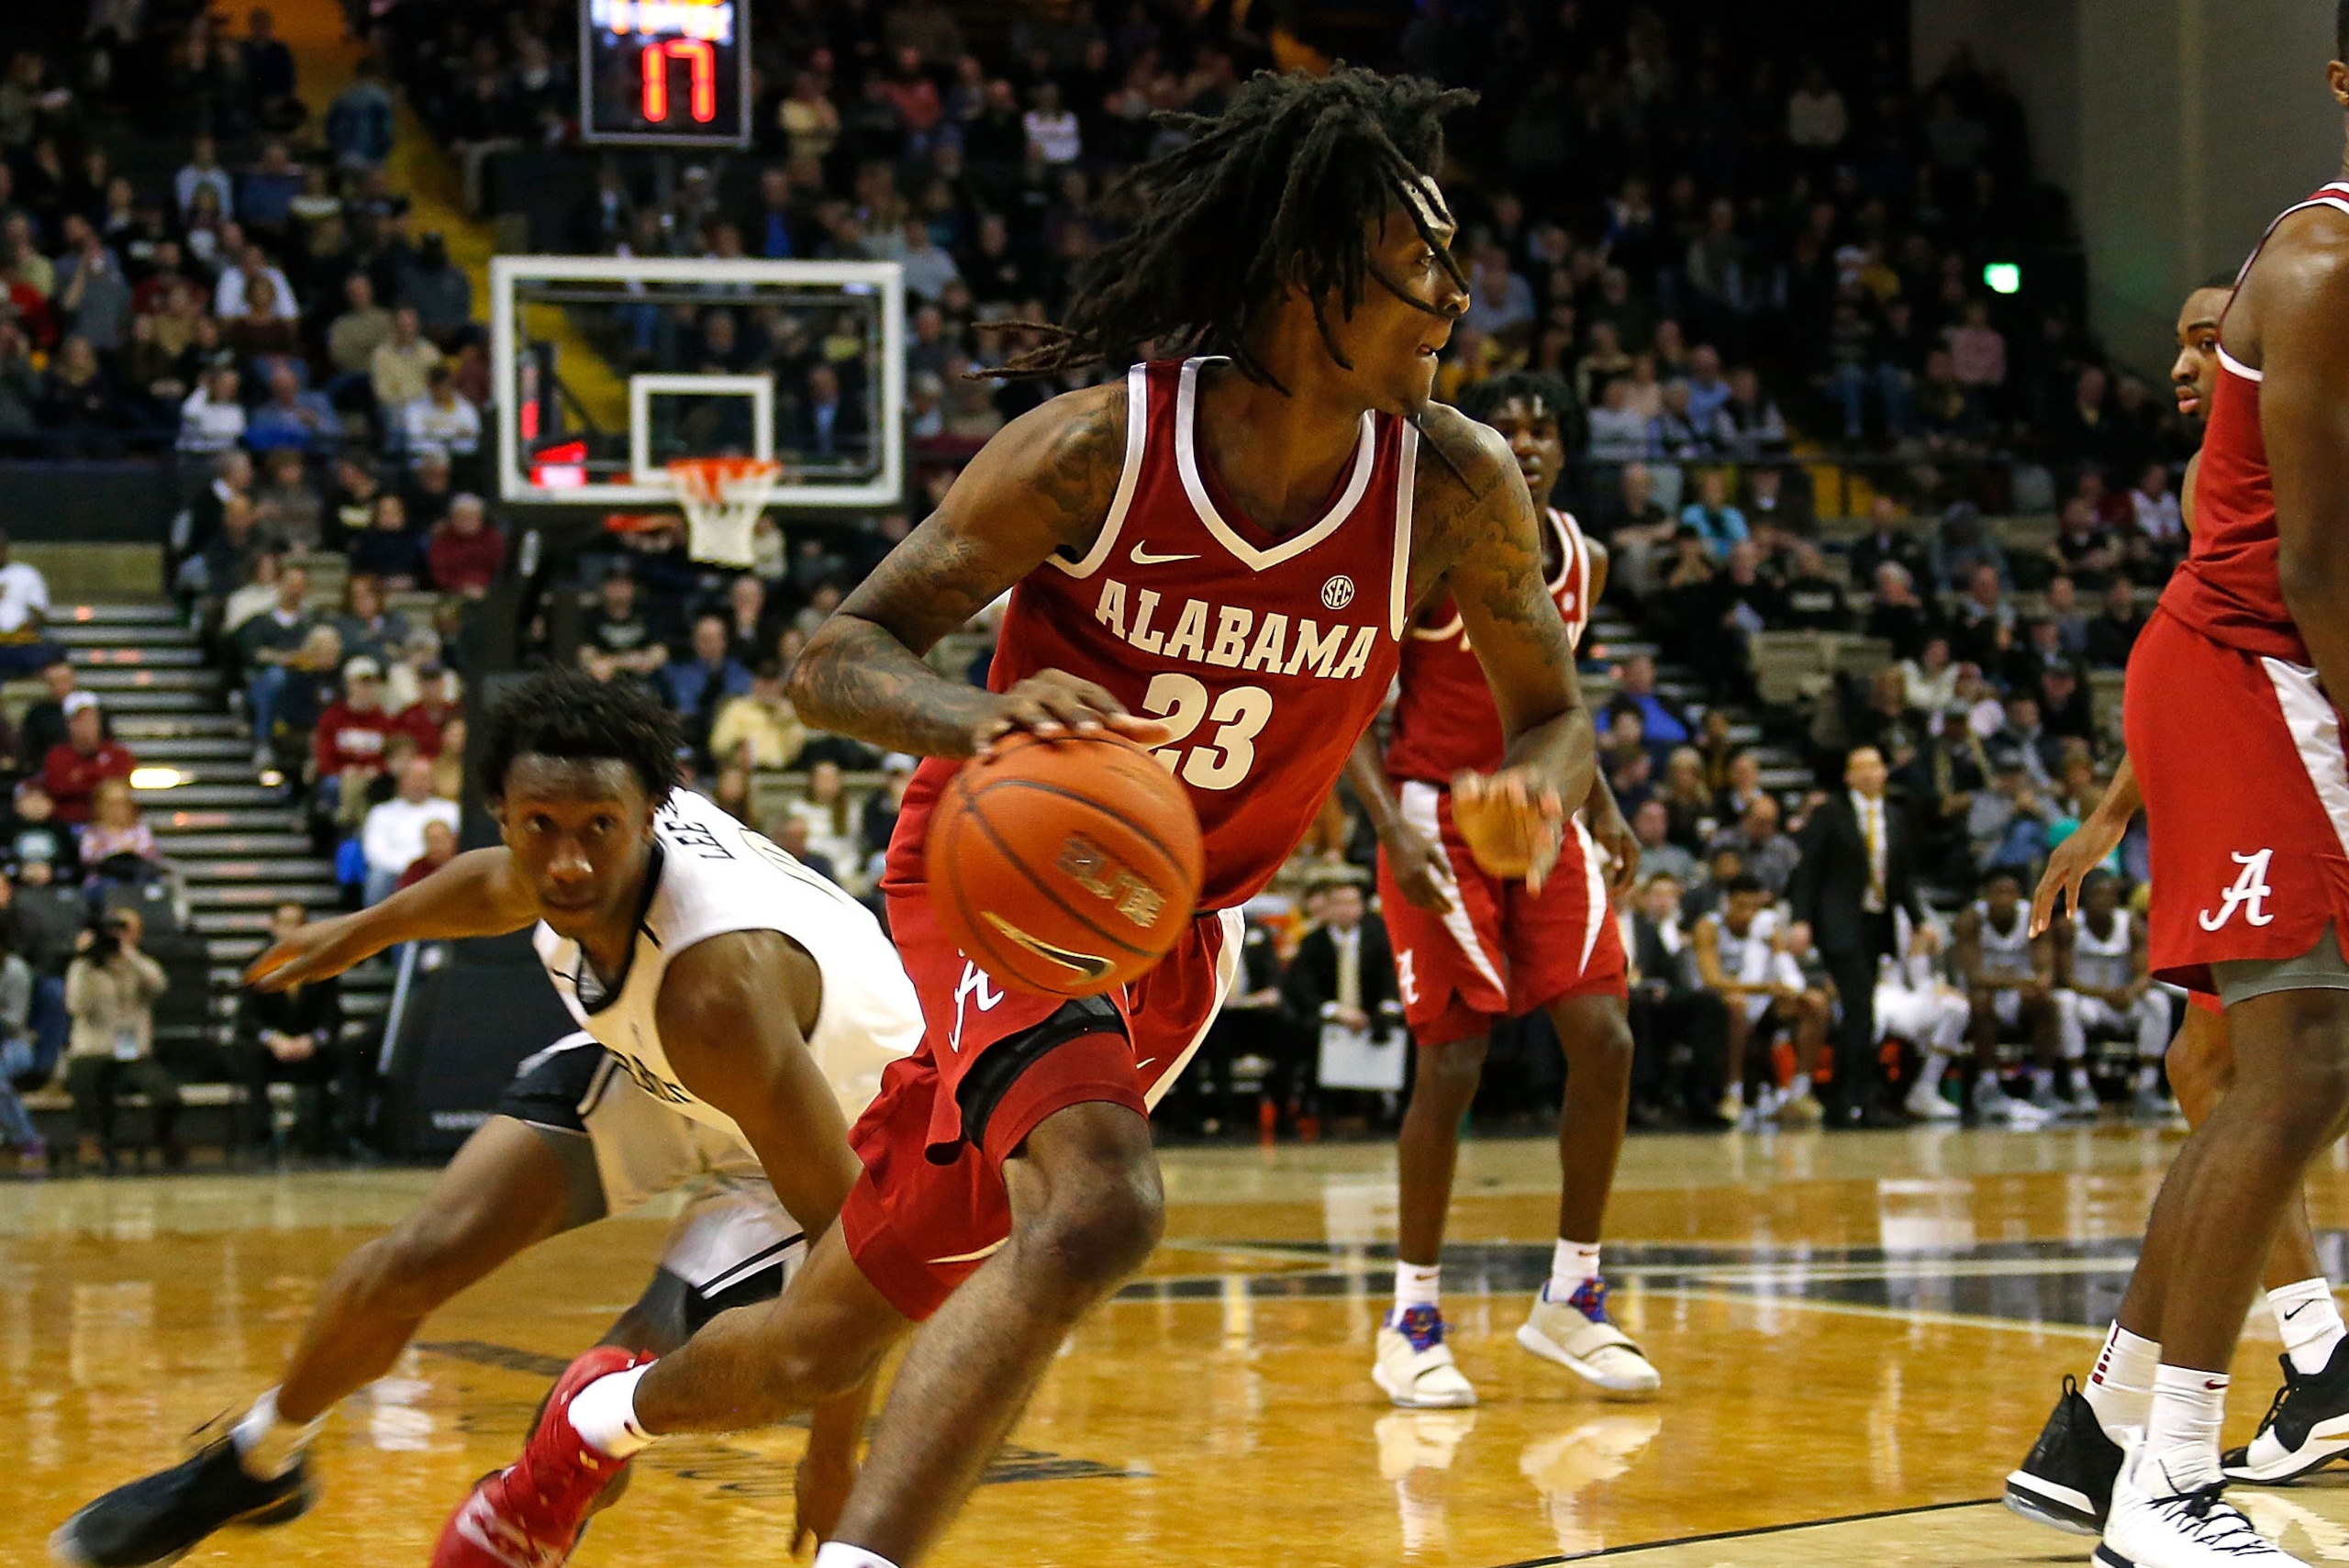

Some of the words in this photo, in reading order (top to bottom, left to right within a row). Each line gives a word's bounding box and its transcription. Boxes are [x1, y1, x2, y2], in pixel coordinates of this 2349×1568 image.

[642, 38, 717, 123] 17
[1095, 578, 1378, 679] ALABAMA
[1324, 578, 1352, 608] SEC
[1141, 673, 1273, 790] 23
[663, 819, 737, 861] LEE
[2199, 848, 2275, 932] A
